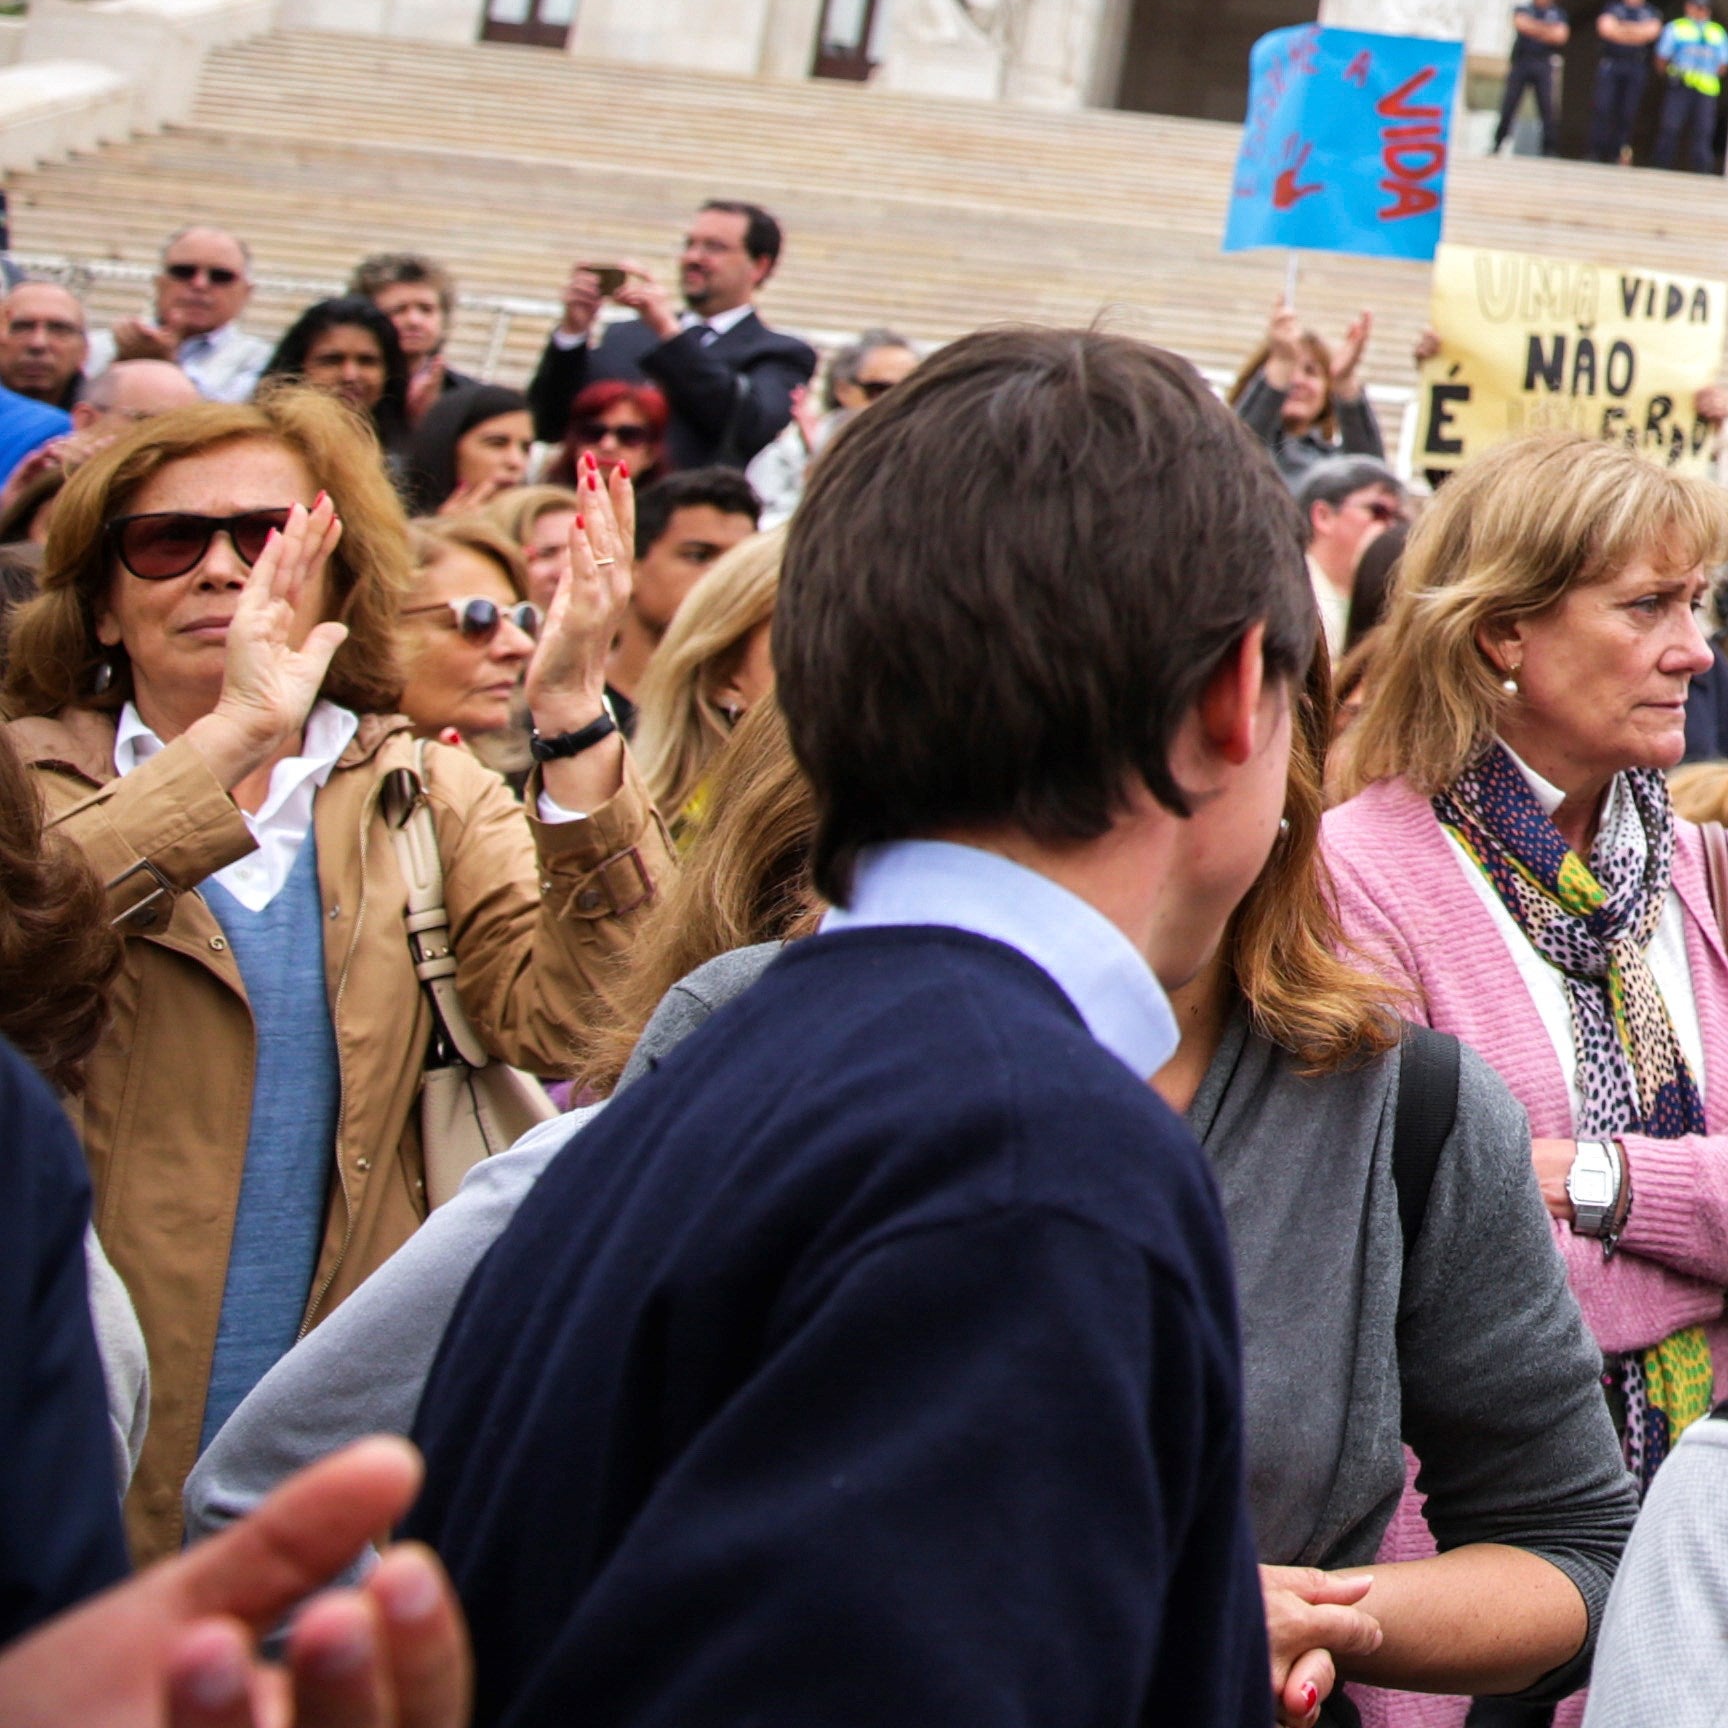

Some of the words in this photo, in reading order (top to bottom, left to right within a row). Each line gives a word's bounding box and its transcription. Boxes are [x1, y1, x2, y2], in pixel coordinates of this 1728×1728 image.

[1377, 66, 1446, 222] VIDA
[1474, 252, 1599, 323] UMA
[1621, 275, 1709, 323] VIDA
[1523, 321, 1635, 397] NÃO
[1424, 363, 1471, 455] É
